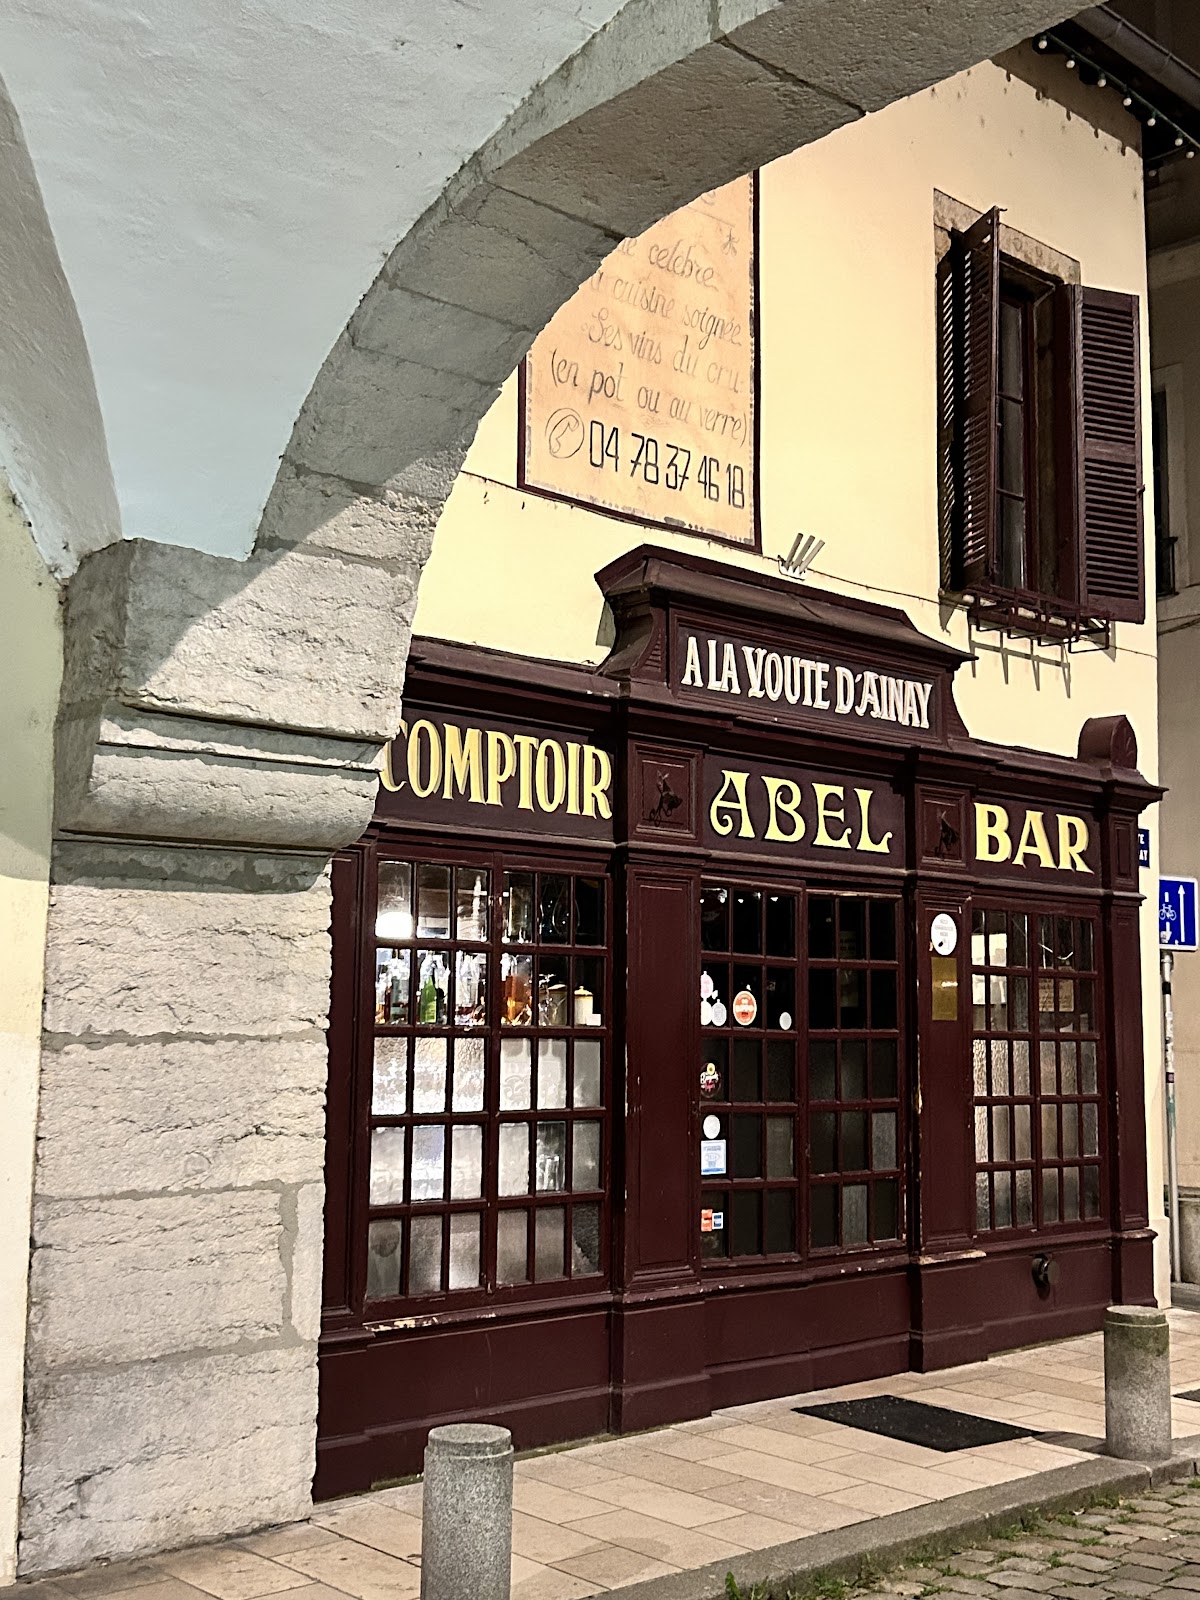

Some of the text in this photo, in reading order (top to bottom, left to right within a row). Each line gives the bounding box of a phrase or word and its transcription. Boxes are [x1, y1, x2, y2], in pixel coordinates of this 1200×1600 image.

[613, 279, 675, 319] cuisine
[588, 307, 623, 350] Ses
[629, 331, 662, 365] vins
[673, 334, 699, 378] du
[551, 347, 578, 387] (en
[588, 362, 625, 404] pot
[637, 386, 660, 413] ou
[670, 397, 691, 424] au
[590, 420, 745, 509] 04 78 37 46 18
[681, 636, 933, 729] A LA VOUTE D'AINAY
[710, 769, 893, 854] ABEL
[973, 801, 1095, 874] BAR
